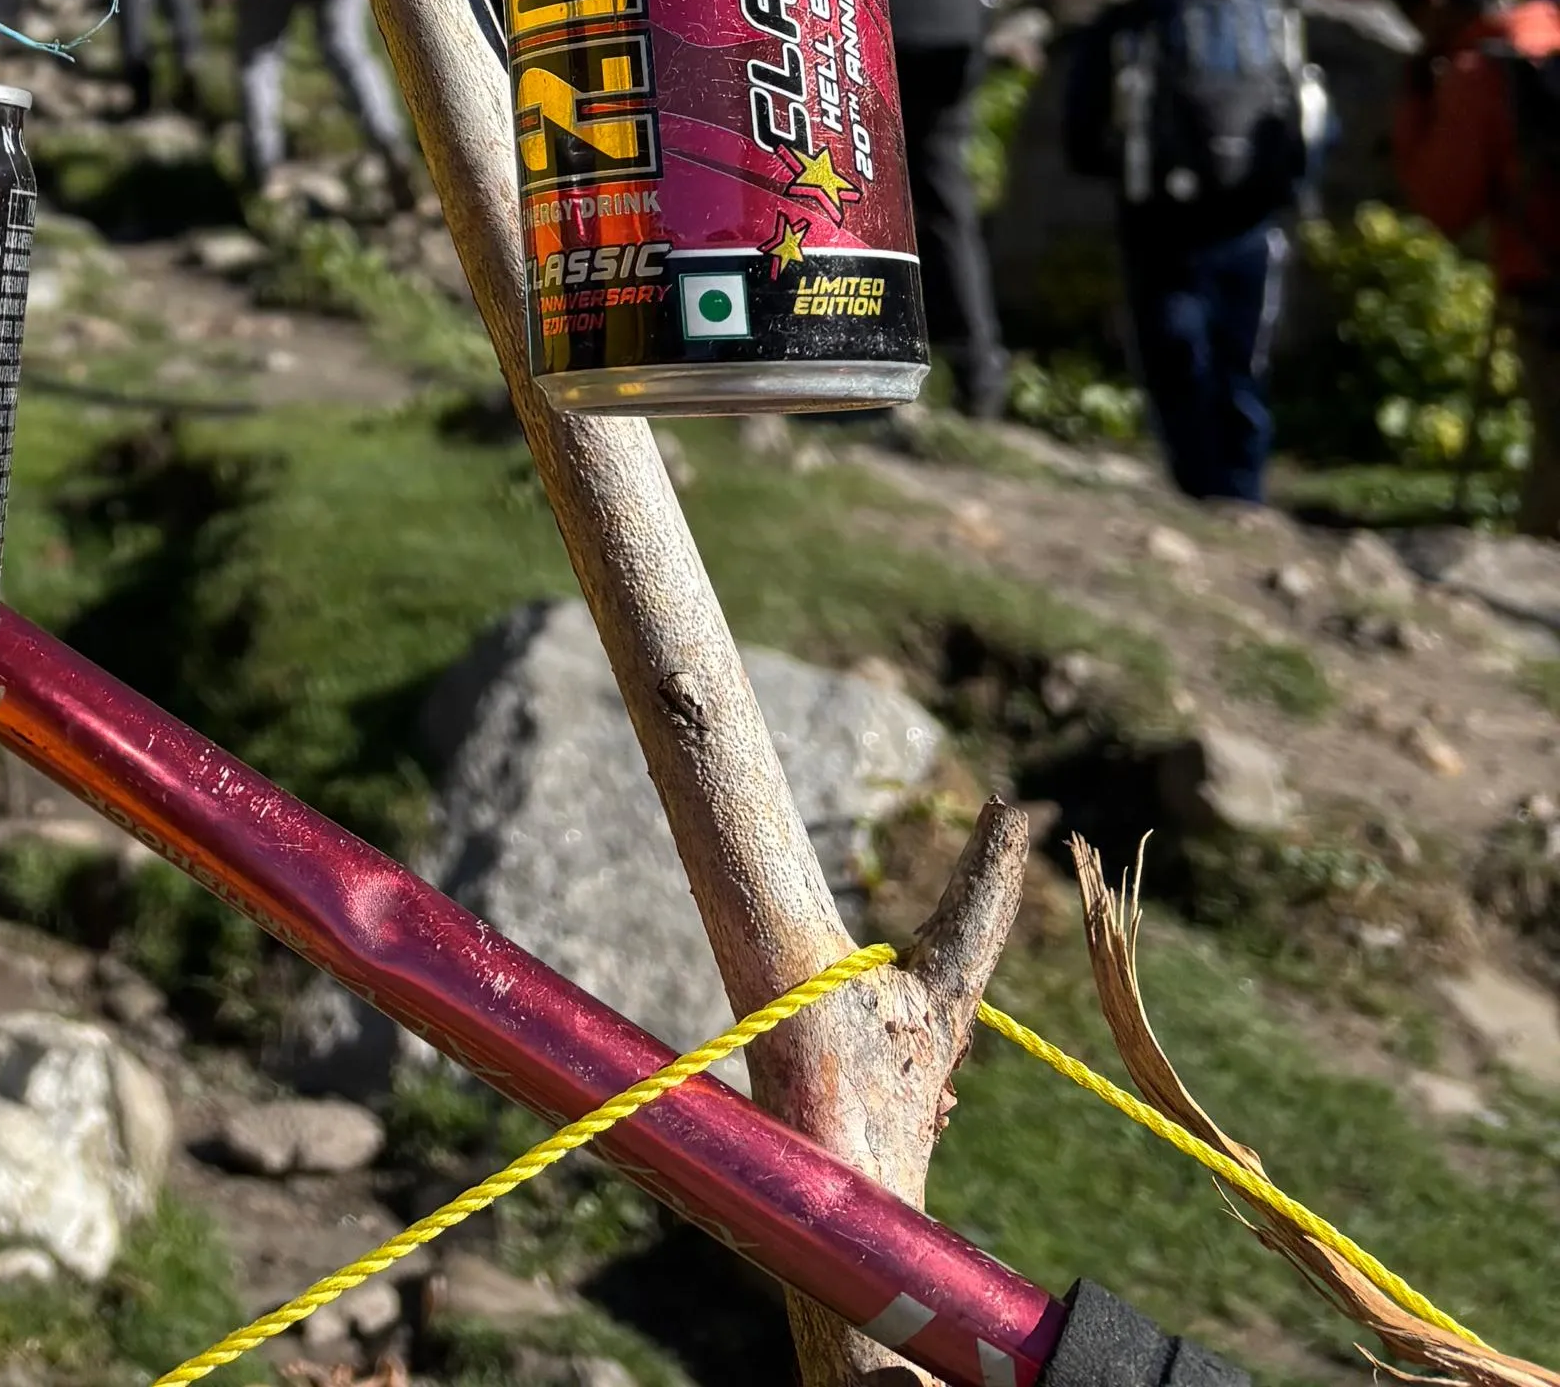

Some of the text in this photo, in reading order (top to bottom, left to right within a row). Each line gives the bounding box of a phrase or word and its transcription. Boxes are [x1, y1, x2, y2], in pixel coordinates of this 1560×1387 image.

[813, 33, 844, 134] HELL
[581, 190, 662, 219] DRINK
[797, 275, 885, 297] LIMITED
[793, 296, 882, 316] EDITION
[542, 313, 605, 336] EDITION
